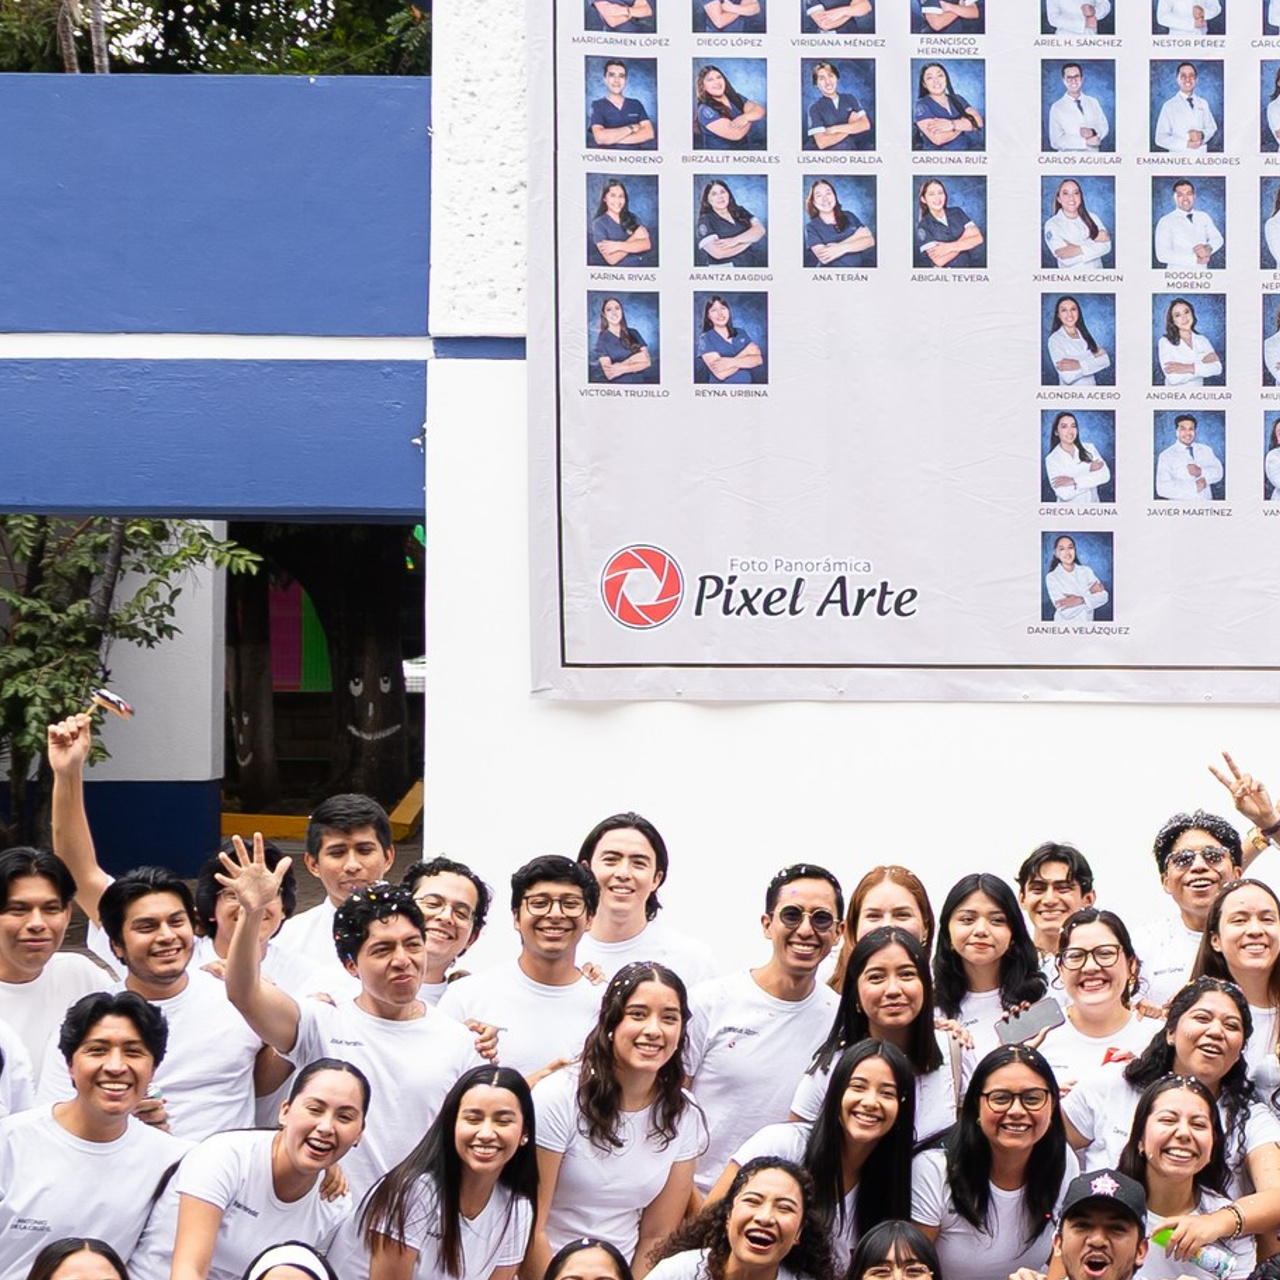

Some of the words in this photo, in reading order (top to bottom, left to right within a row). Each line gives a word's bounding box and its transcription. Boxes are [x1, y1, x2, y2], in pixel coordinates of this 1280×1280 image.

[791, 39, 841, 47] VIRIDIANA
[844, 38, 885, 47] MÉNDEZ
[1194, 39, 1225, 48] PÉREZ
[581, 154, 617, 162] YOBANI
[619, 156, 663, 164] MORENO
[912, 156, 963, 164] CAROLINA
[1038, 156, 1077, 164] CARLOS
[689, 273, 732, 281] ARANTZA
[910, 274, 949, 282] ABIGAIL
[952, 274, 989, 282] TEVERA
[579, 389, 622, 397] VICTORIA
[695, 389, 728, 397] REYNA
[1087, 392, 1121, 400] ACERO
[1038, 508, 1075, 516] GRECIA
[1077, 508, 1117, 516] LAGUNA
[1147, 508, 1180, 516] JAVIER
[1182, 507, 1232, 516] MARTÍNEZ
[730, 558, 768, 572] Foto
[775, 558, 871, 572] Panorámica
[694, 575, 805, 616] Pixel
[816, 575, 918, 617] Arte
[1027, 626, 1070, 634] DANIELA
[1072, 625, 1130, 636] VELÁZQUEZ
